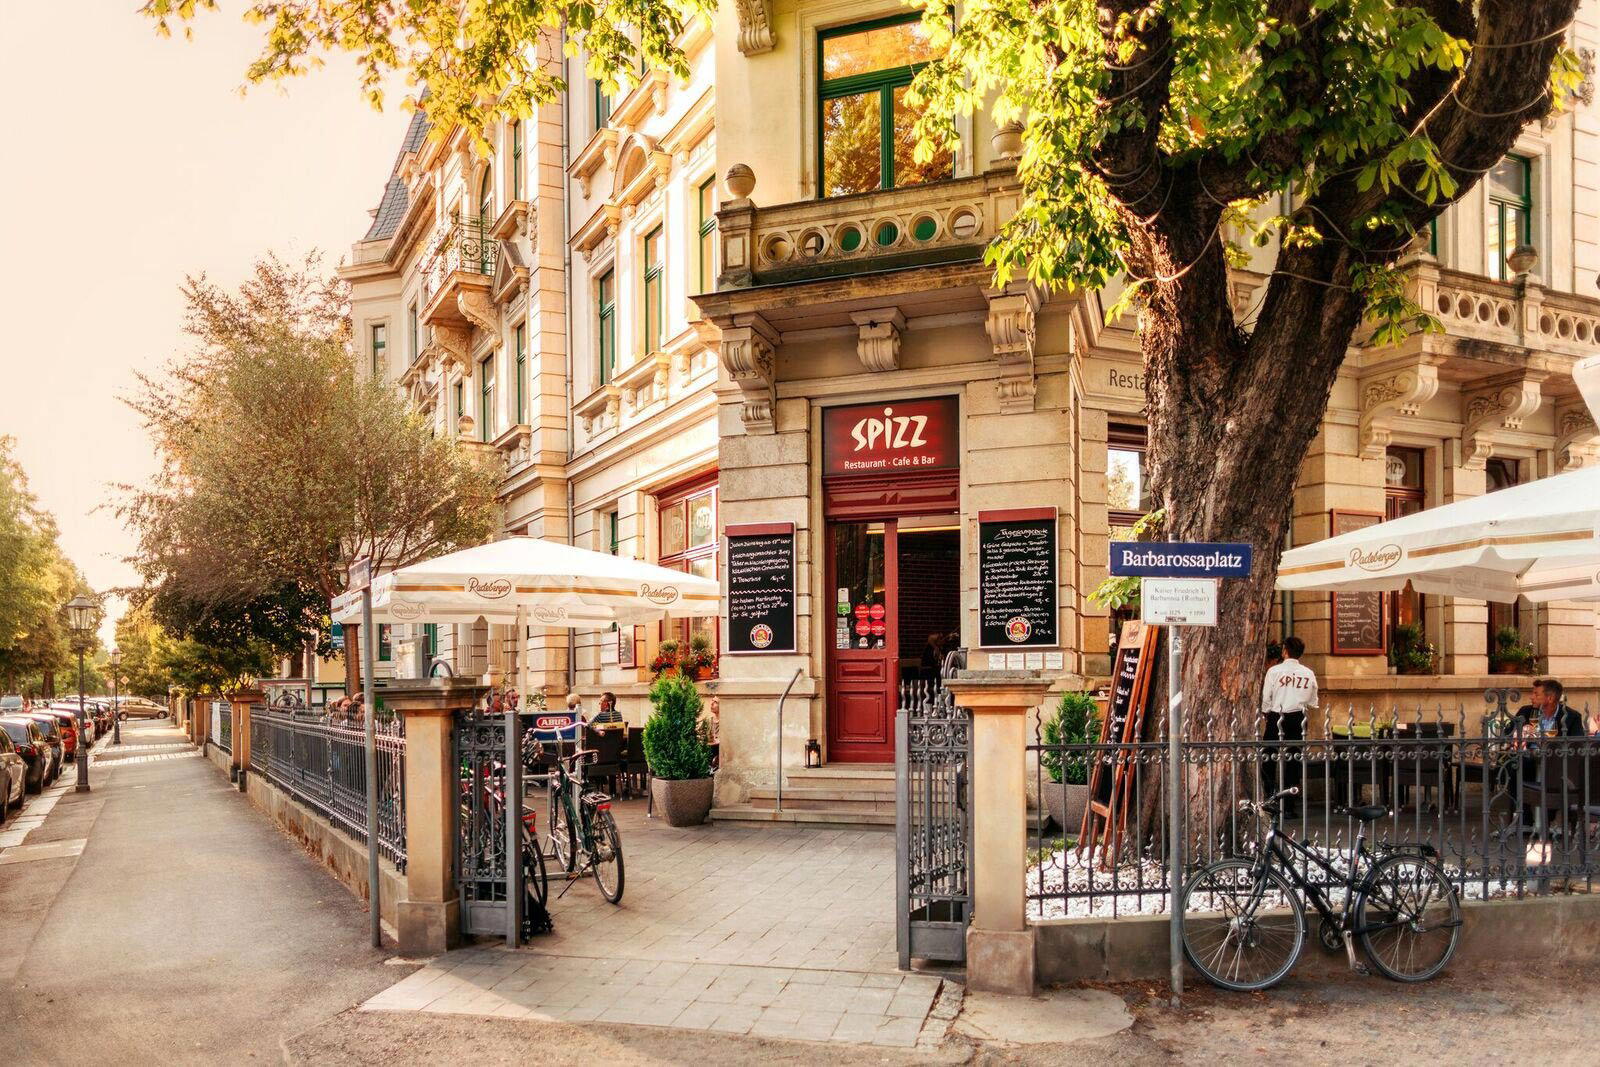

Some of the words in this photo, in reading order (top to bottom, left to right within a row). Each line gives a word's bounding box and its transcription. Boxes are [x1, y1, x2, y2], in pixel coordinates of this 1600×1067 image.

[844, 459, 886, 470] Restaurant
[892, 457, 911, 467] Cafe
[913, 457, 920, 465] &
[921, 456, 936, 465] Bar
[1122, 550, 1242, 570] Barbarossaplatz
[1349, 545, 1402, 569] Radeberger
[469, 577, 511, 597] Radeberger
[640, 583, 678, 602] Radeberger
[541, 718, 568, 728] ABUS
